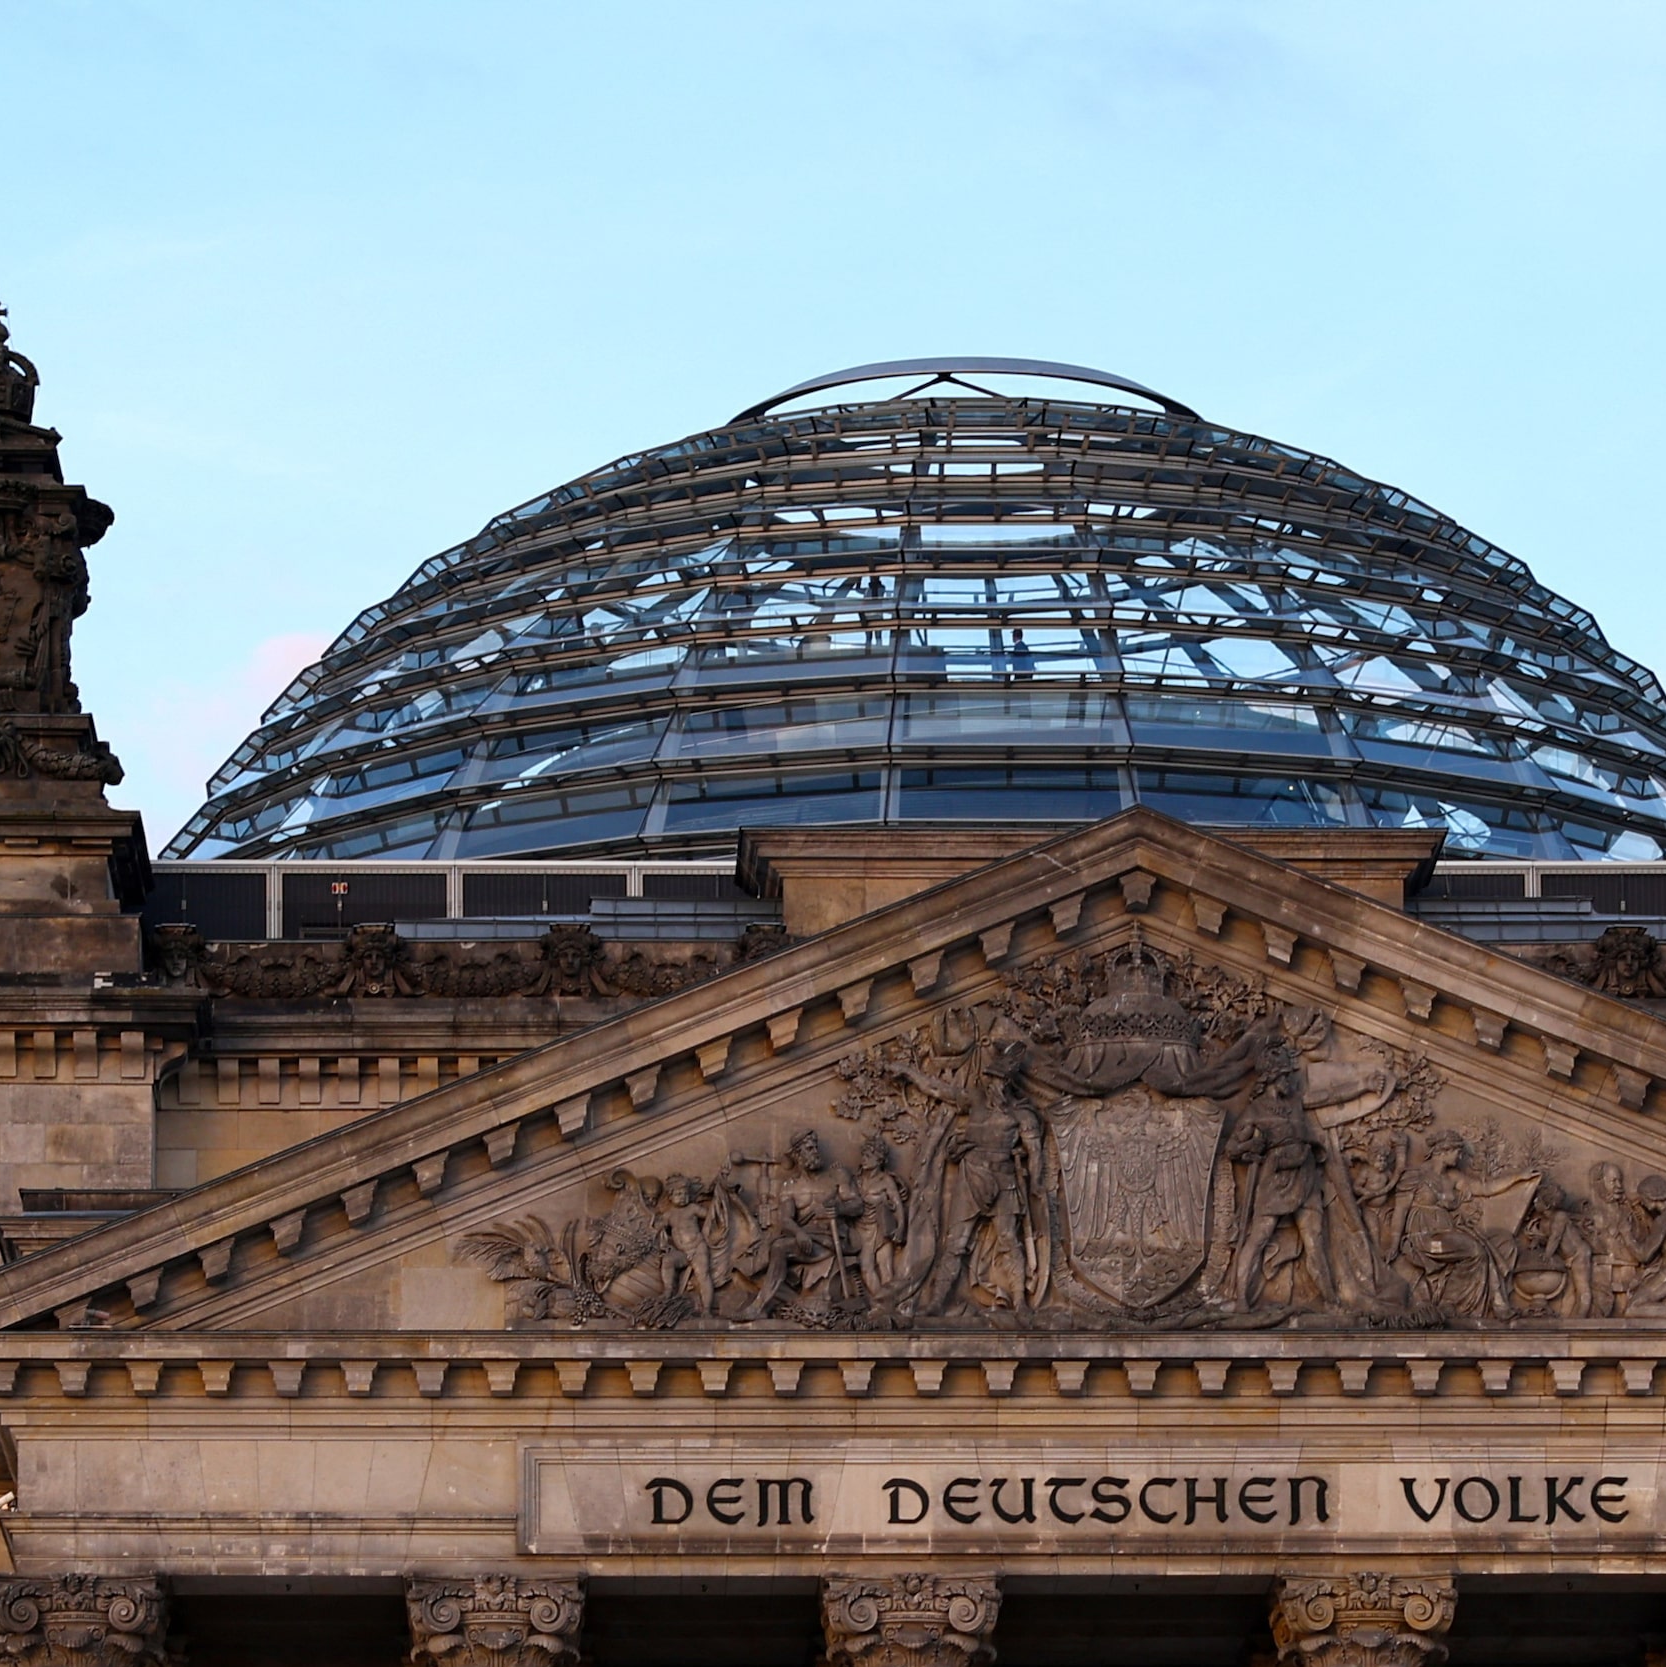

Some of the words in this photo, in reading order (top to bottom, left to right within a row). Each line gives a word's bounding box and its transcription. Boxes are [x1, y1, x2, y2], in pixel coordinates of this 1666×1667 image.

[644, 1476, 815, 1527] DEM
[881, 1475, 1330, 1526] DEUTSCHEN
[1399, 1475, 1630, 1525] VOLKE
